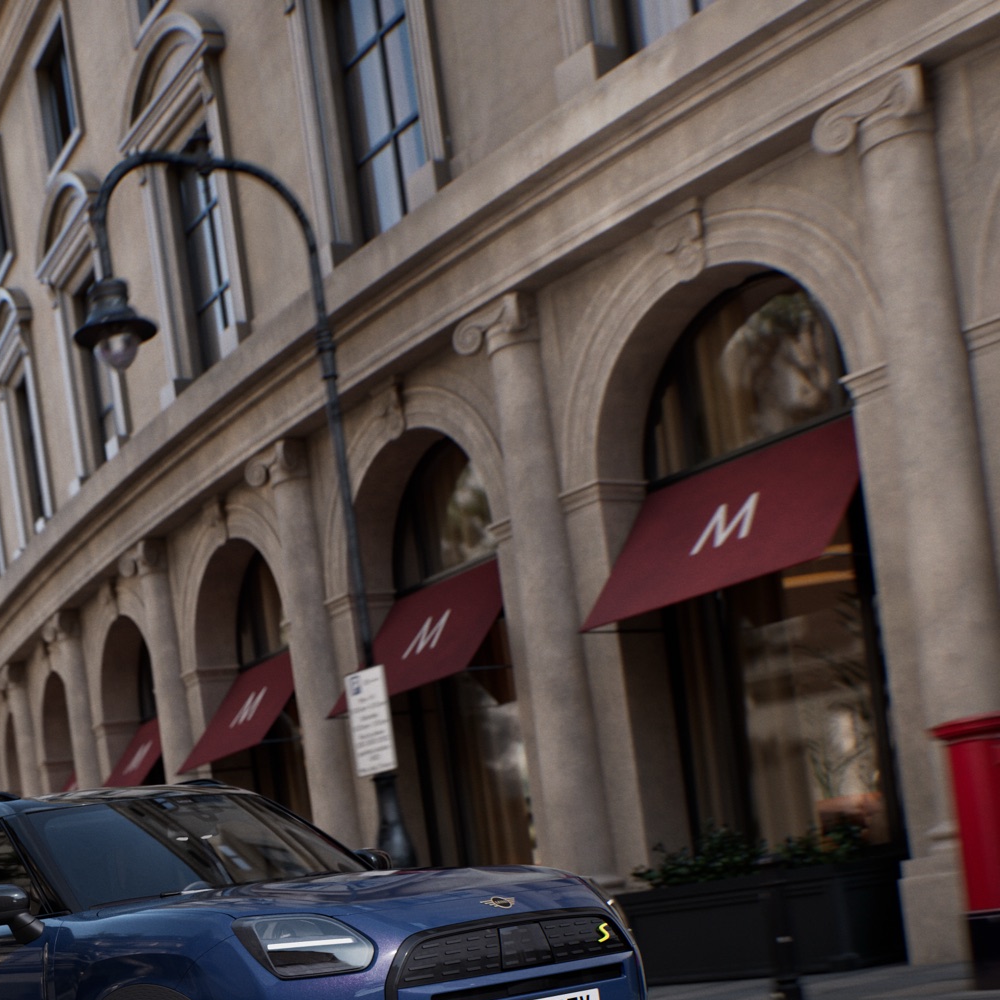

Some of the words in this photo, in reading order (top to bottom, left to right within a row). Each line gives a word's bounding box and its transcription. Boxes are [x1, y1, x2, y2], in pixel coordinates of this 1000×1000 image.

[689, 491, 761, 557] M
[401, 608, 452, 660] M
[228, 685, 268, 729] M
